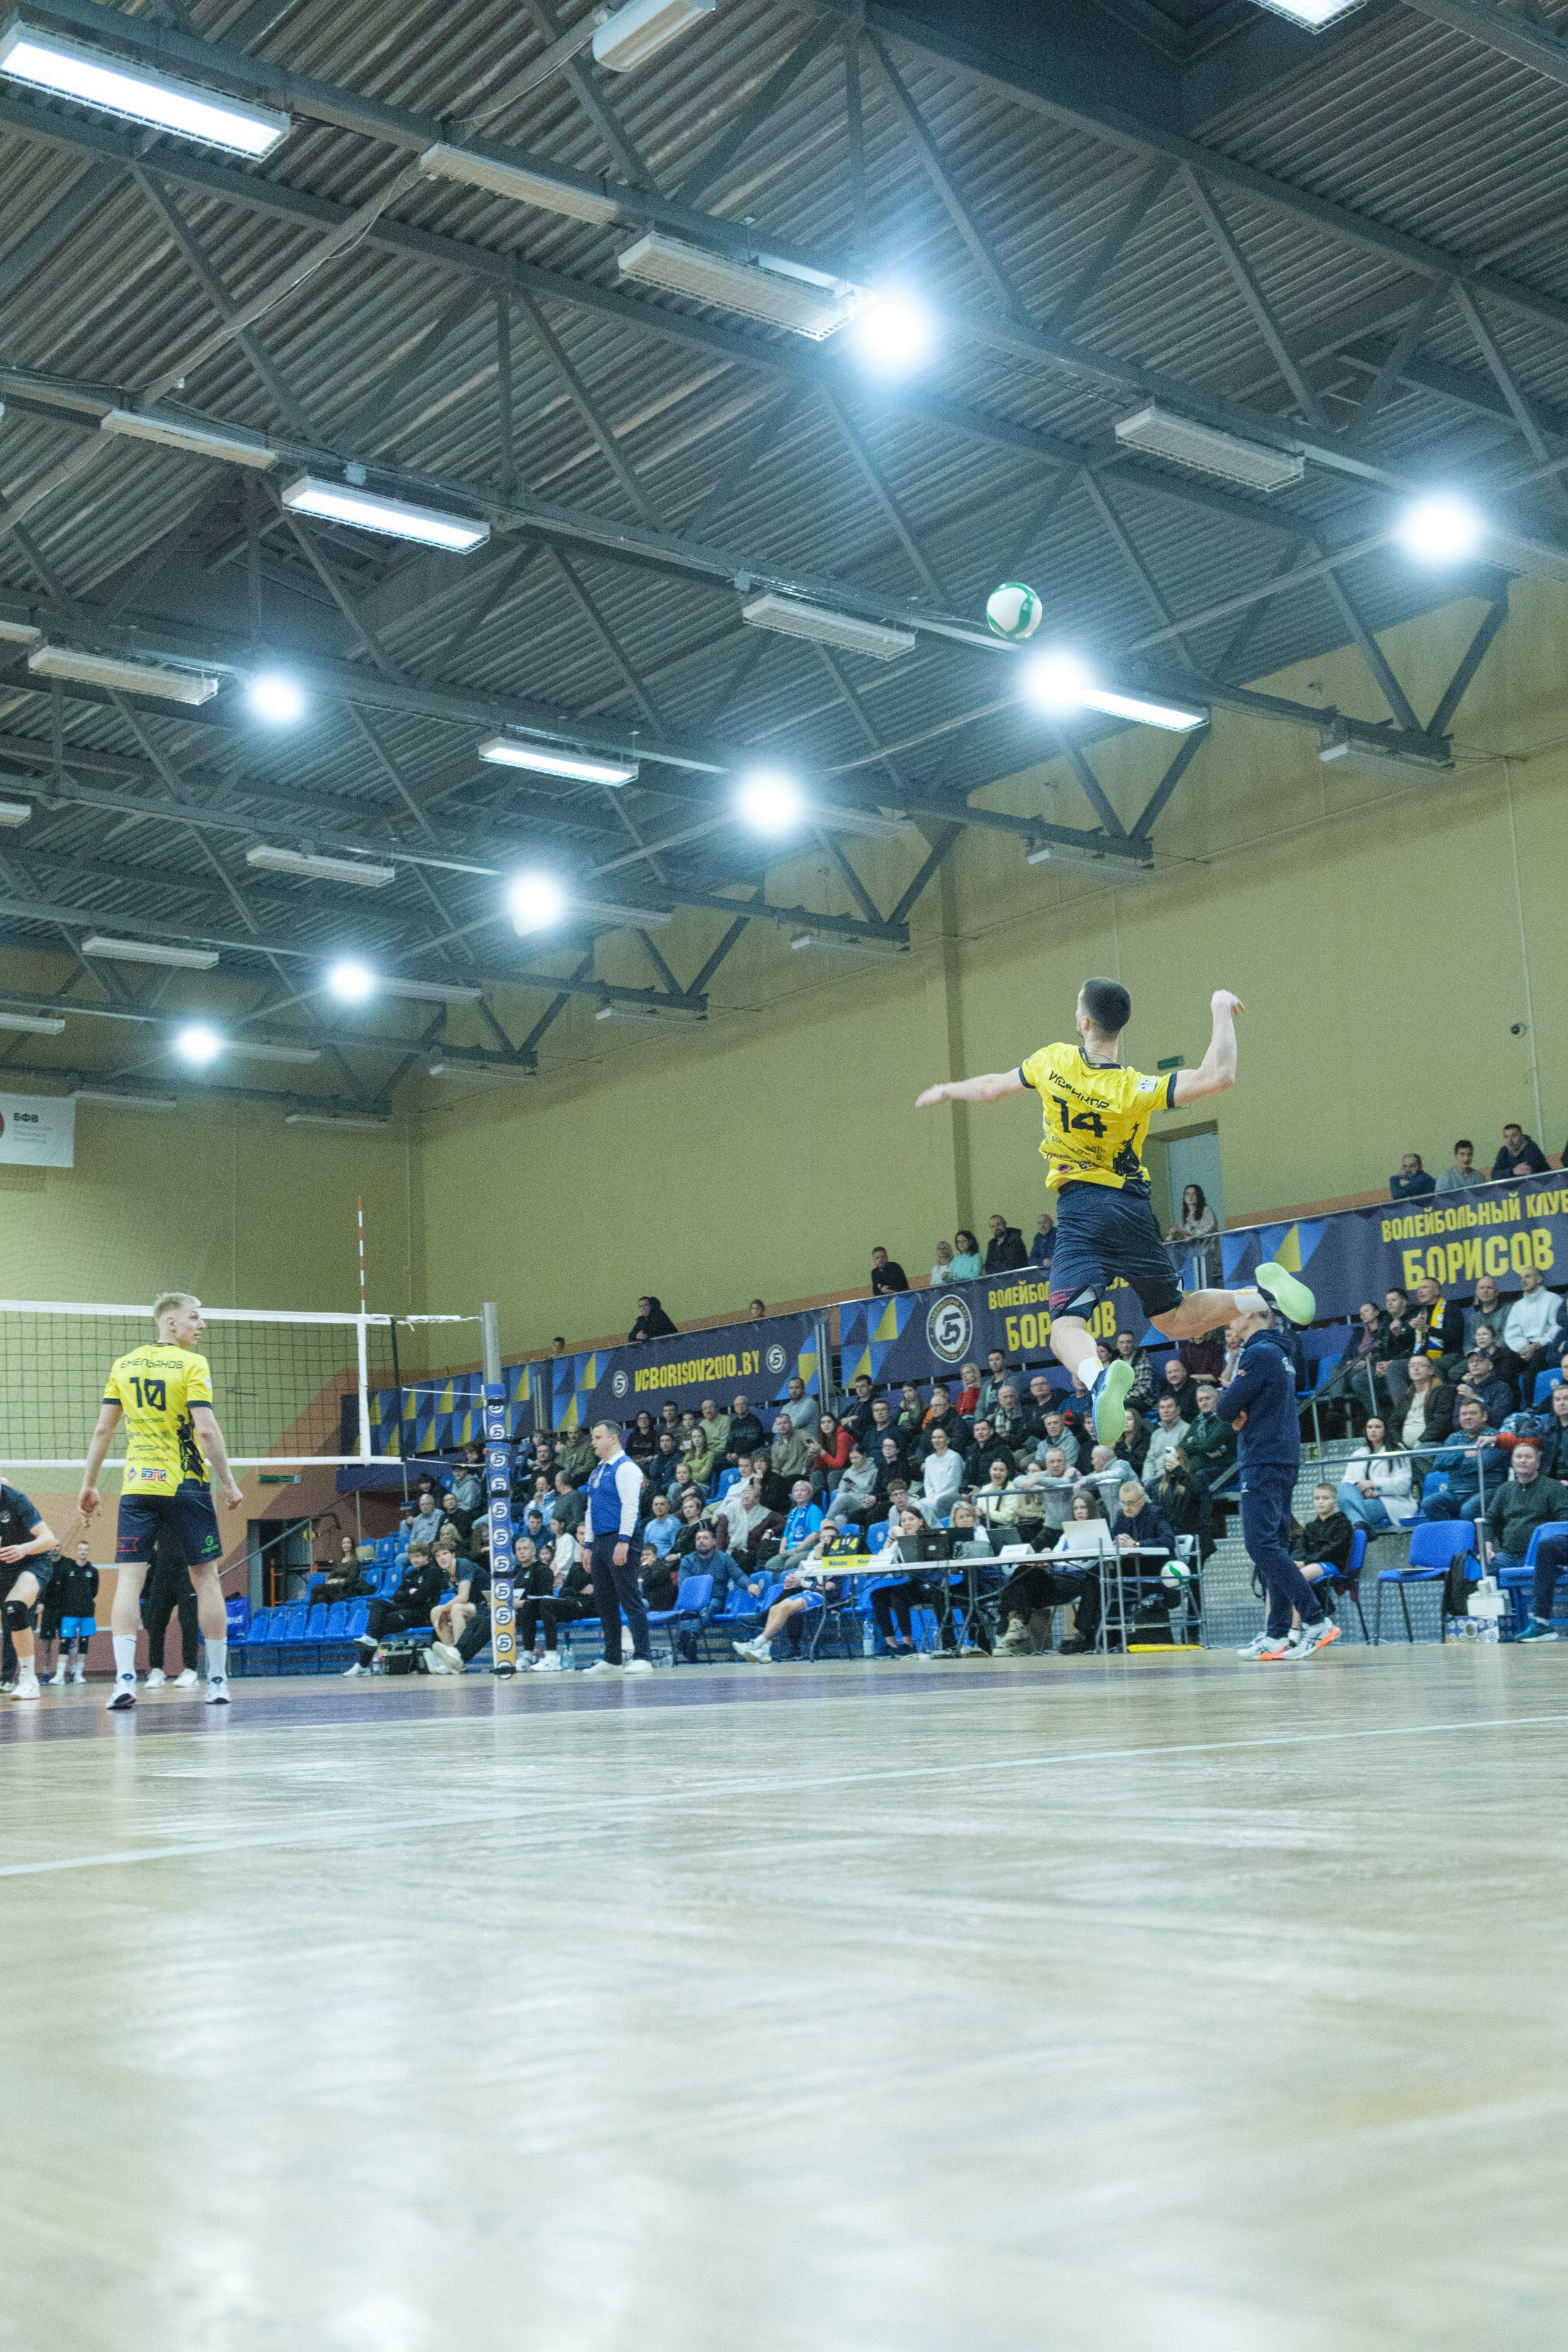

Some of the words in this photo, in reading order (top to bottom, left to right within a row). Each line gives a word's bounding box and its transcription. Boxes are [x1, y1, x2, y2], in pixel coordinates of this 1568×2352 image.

[13, 1112, 39, 1123] БФВ
[1052, 1095, 1107, 1139] 14
[1381, 1191, 1521, 1243] ВОЛЕЙБОЛЬНЫЙ
[1403, 1228, 1554, 1291] БОРИСОВ
[1005, 1311, 1117, 1351] БОРОВ
[121, 1358, 183, 1369] ЕМЕЛЬЯНОВ
[635, 1350, 760, 1392] VCBORISOV2010.BY
[130, 1377, 167, 1411] 10
[831, 1539, 840, 1550] 4
[849, 1537, 858, 1549] 4
